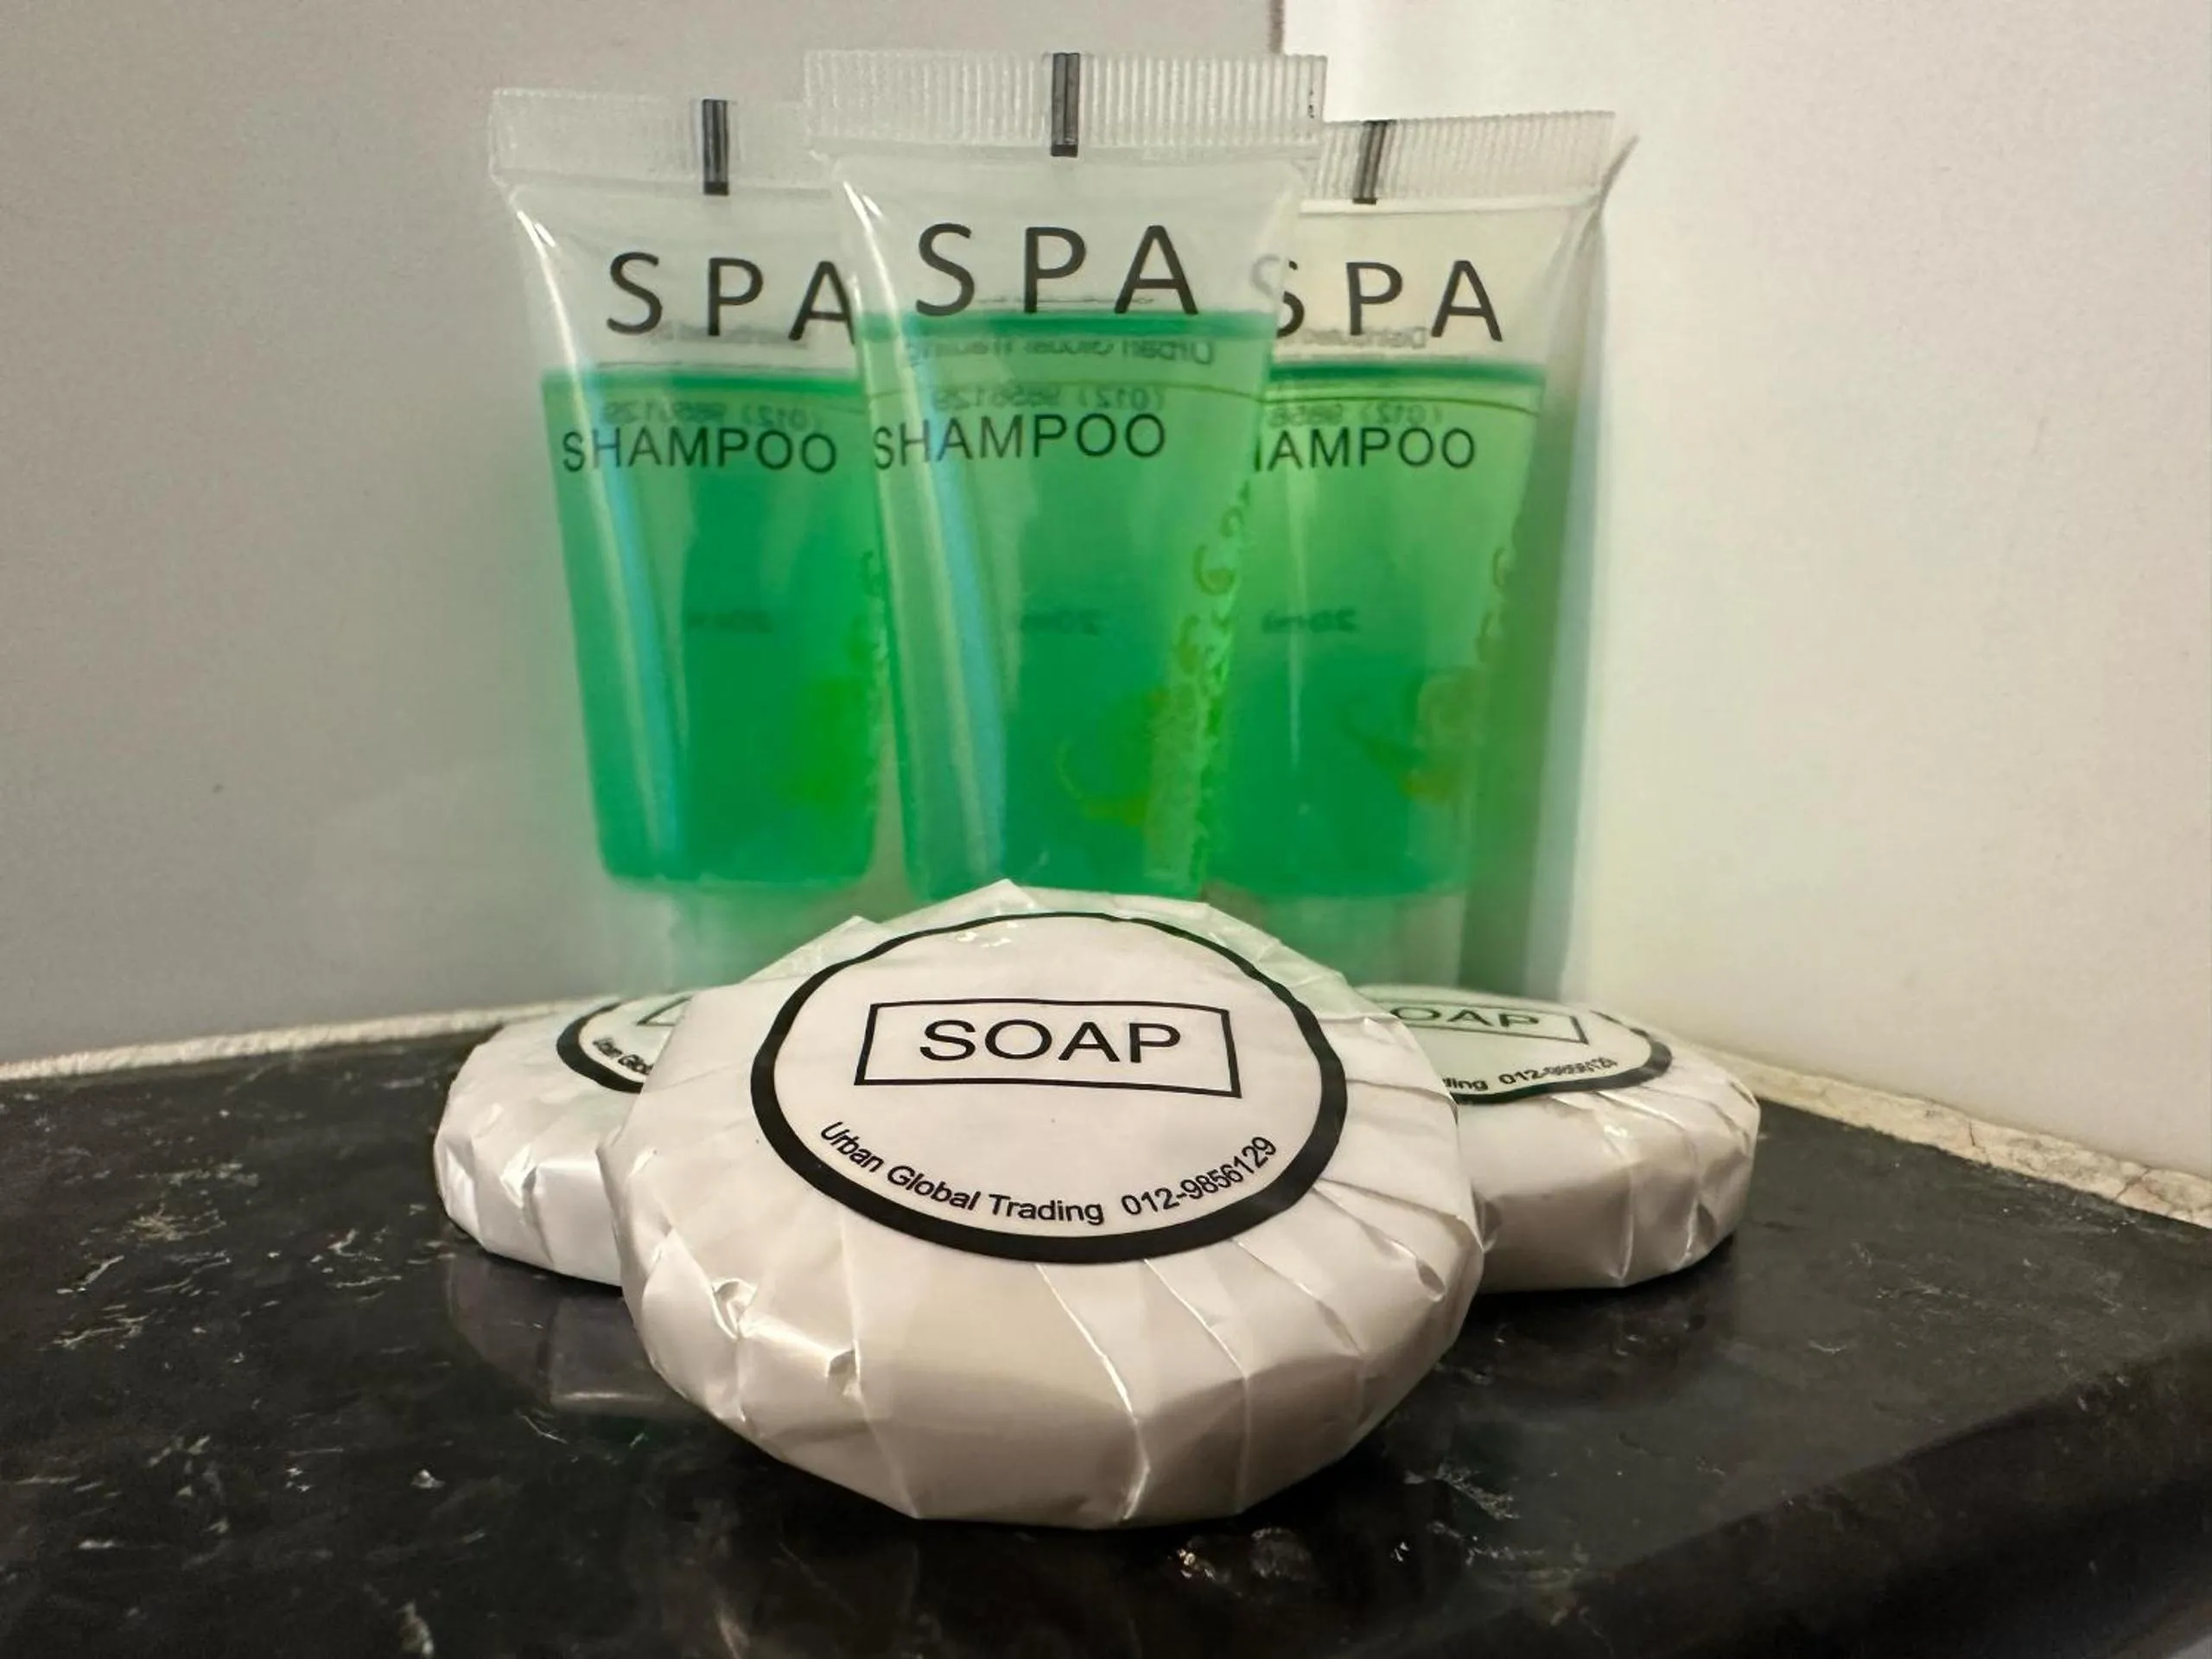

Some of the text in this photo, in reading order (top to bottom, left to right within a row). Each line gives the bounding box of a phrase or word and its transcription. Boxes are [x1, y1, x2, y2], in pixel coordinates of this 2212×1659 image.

[607, 251, 855, 345] SPA
[915, 222, 1199, 316] SPA
[1250, 254, 1503, 342] SPA
[563, 426, 838, 474] SHAMPOO
[872, 413, 1166, 471] SHAMPOO
[1255, 427, 1477, 474] AMPOO
[918, 1018, 1181, 1064] SOAP
[1389, 1006, 1540, 1028] OAP
[820, 1121, 1277, 1227] Urban Global Trading 012-9856129
